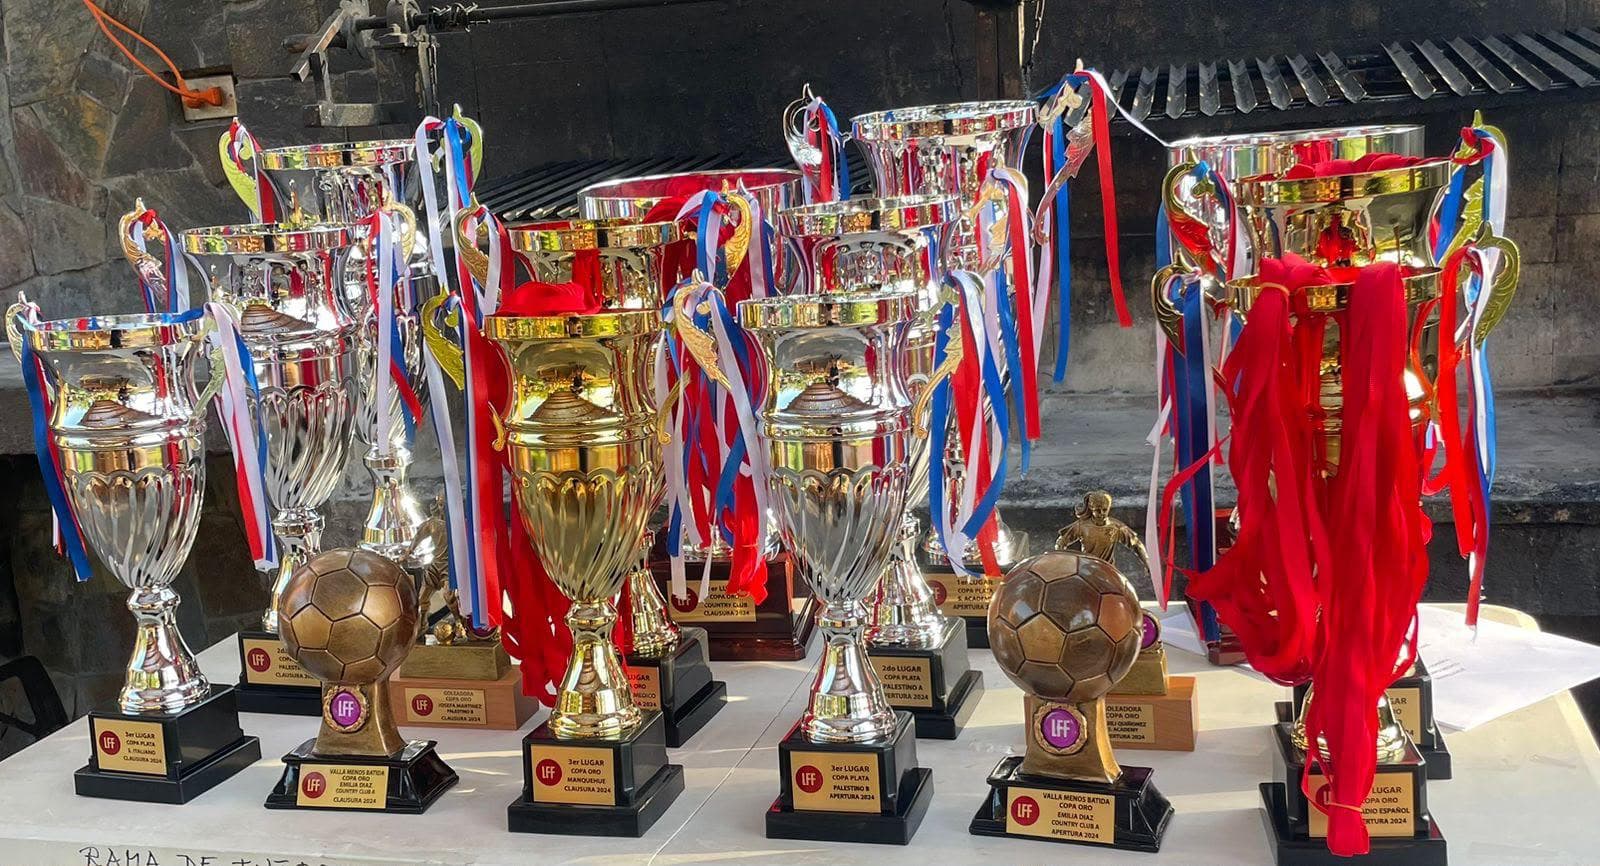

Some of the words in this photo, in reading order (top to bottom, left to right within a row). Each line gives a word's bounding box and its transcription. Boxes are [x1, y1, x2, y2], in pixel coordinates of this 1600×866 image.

[252, 654, 265, 666] LFF
[338, 701, 354, 717] LFF
[416, 700, 427, 710] LFF
[1052, 719, 1071, 738] LFF
[104, 737, 115, 749] LFF
[542, 766, 555, 779] LFF
[802, 772, 816, 786] LFF
[308, 779, 320, 792] LFF
[1043, 792, 1062, 800] VALLA
[1088, 797, 1110, 805] BATIDA
[1018, 803, 1032, 818] LFF
[1052, 820, 1078, 828] COUNTRY
[1052, 829, 1083, 837] APERTURA
[1084, 831, 1098, 839] 2024
[79, 846, 160, 866] RAMA
